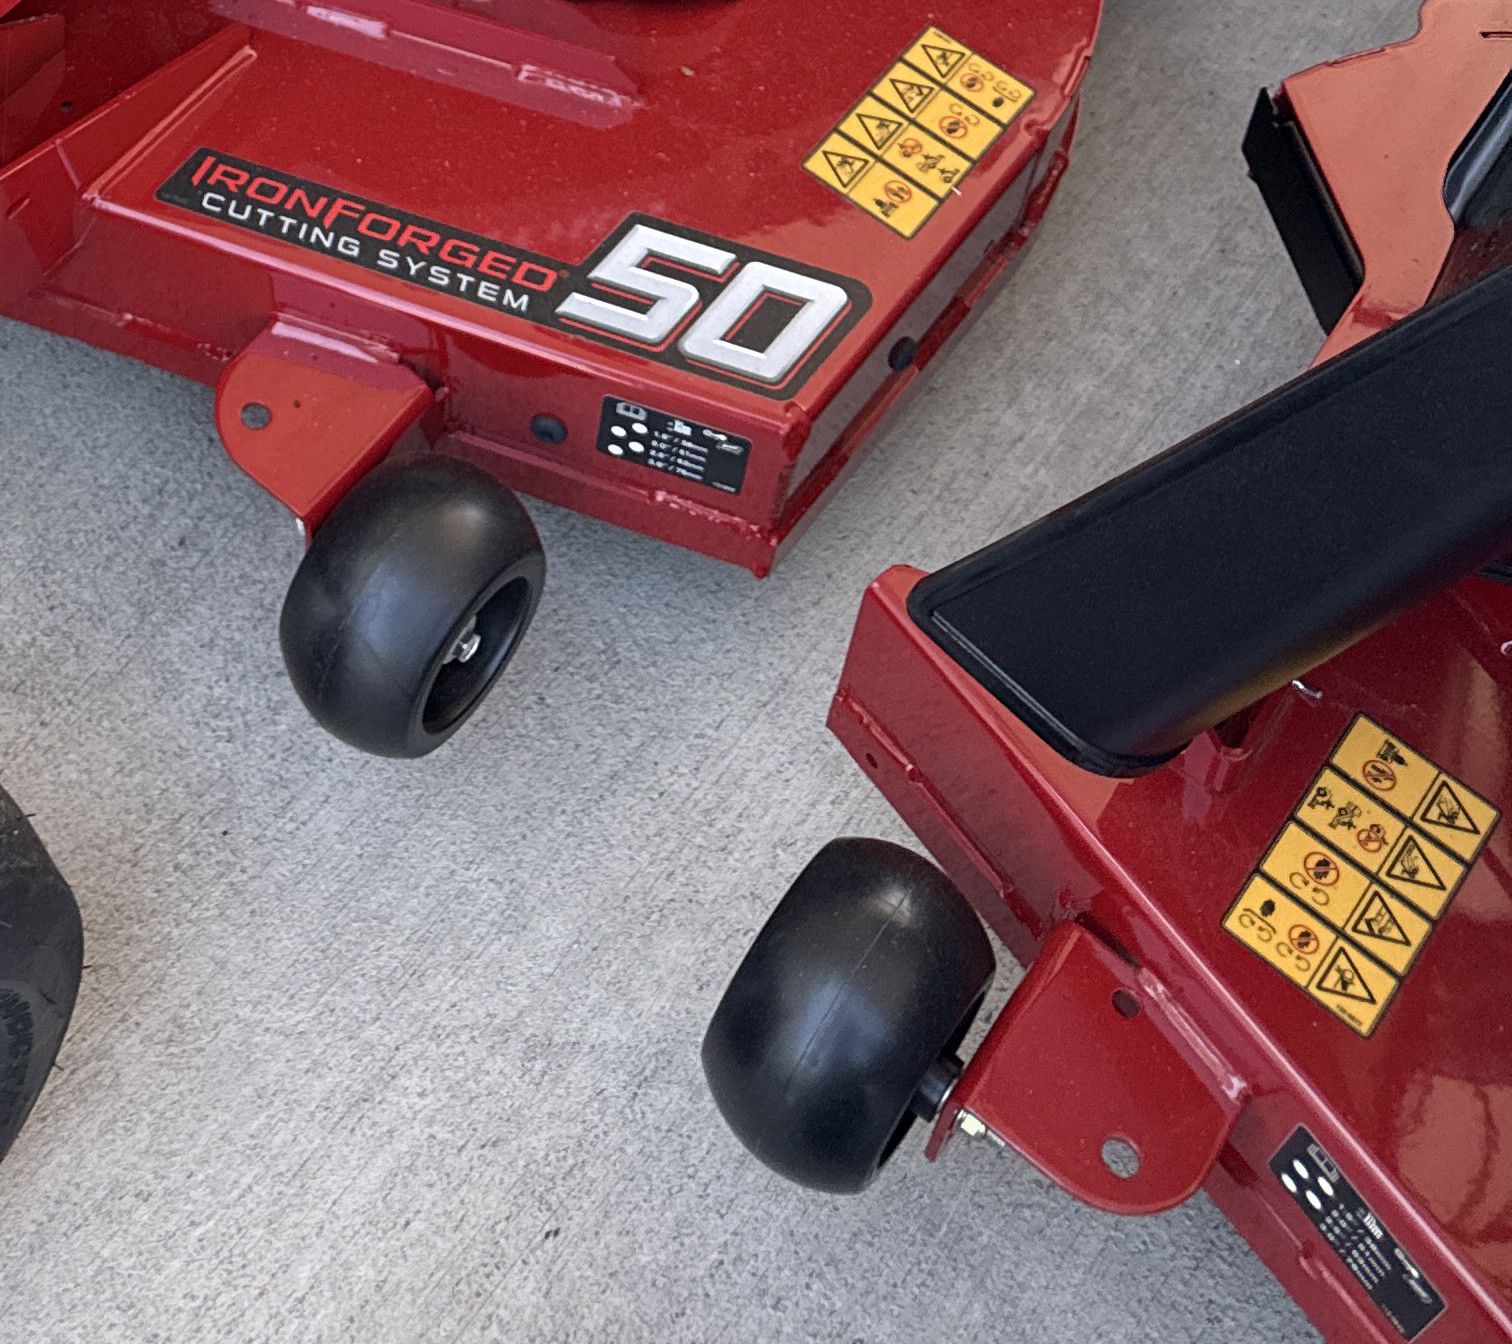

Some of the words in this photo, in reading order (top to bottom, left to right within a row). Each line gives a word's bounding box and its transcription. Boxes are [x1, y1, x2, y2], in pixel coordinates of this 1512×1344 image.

[191, 155, 560, 293] IRONFORGED
[200, 190, 361, 259] CUTTING
[376, 248, 530, 313] SYSTEM
[554, 223, 851, 385] 50
